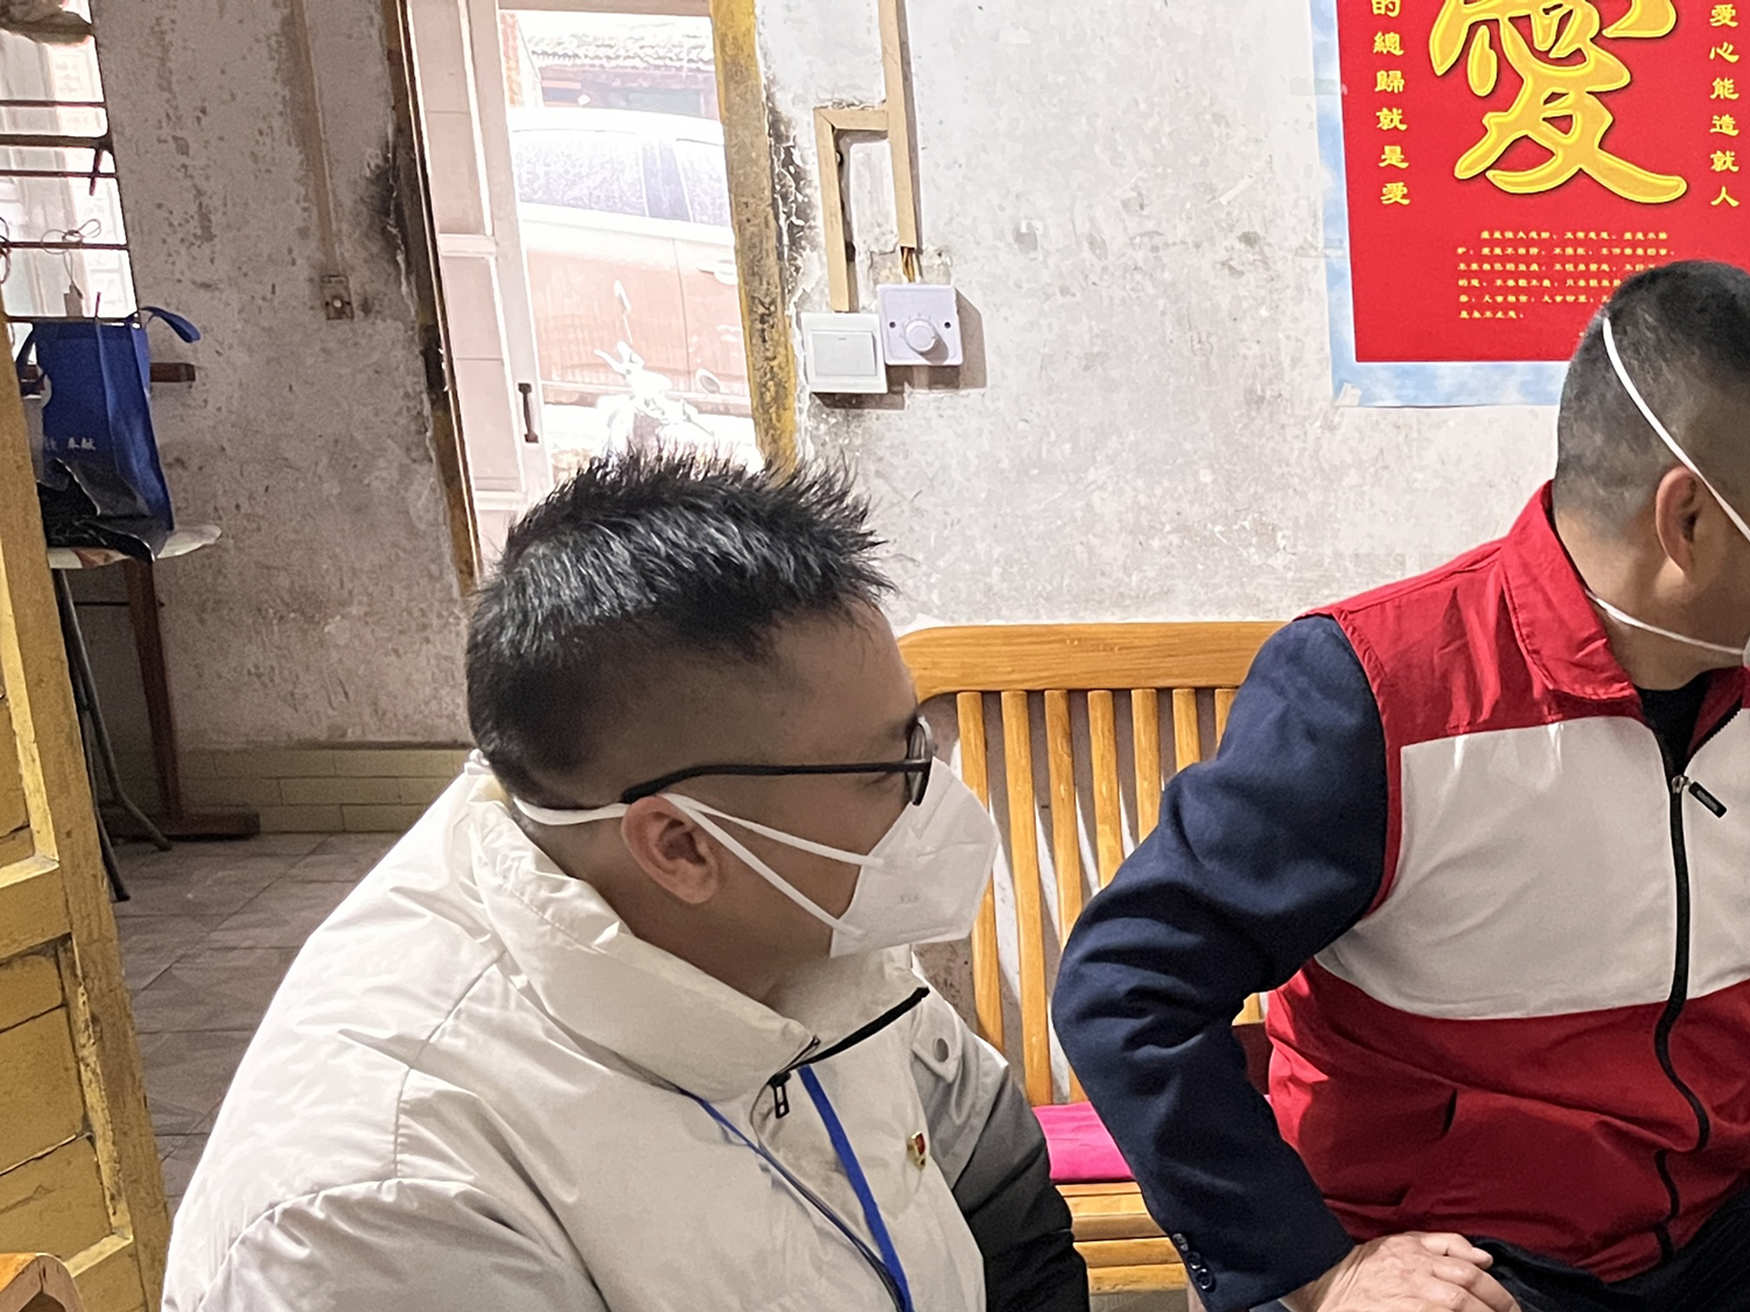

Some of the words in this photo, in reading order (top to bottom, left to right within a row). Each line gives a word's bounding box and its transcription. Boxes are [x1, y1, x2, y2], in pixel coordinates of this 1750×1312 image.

[1709, 3, 1740, 208] 愛心能造就人
